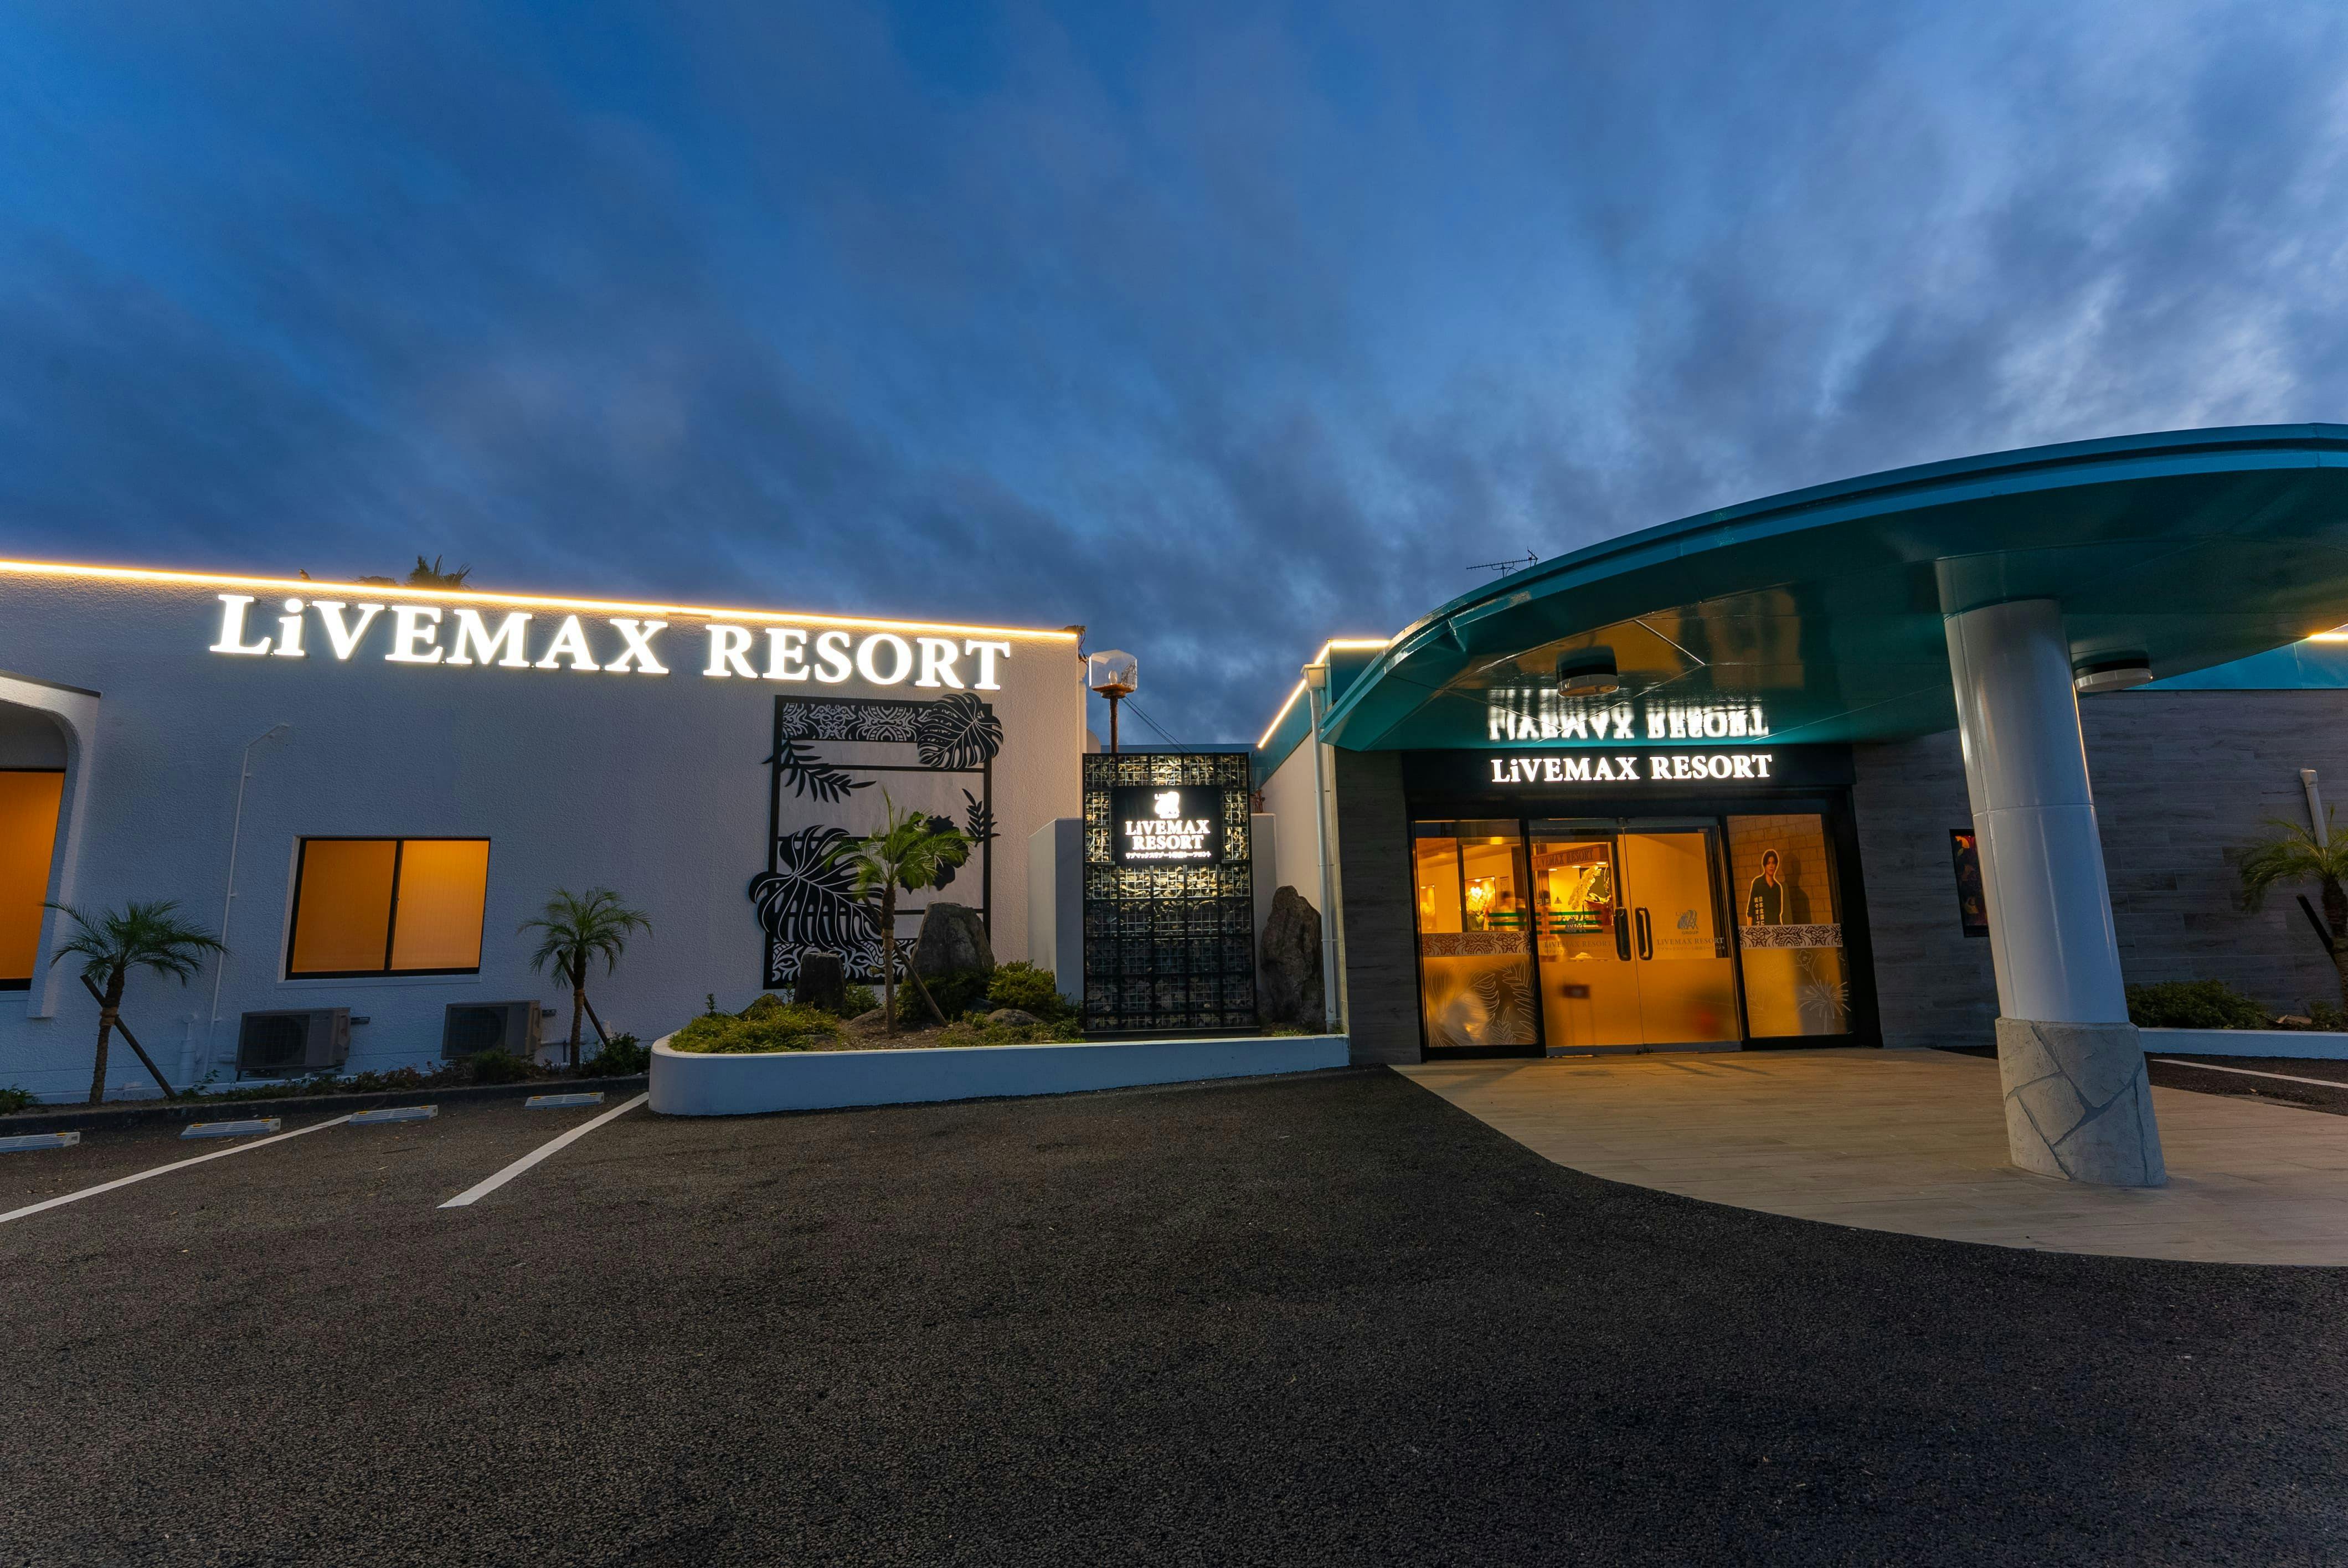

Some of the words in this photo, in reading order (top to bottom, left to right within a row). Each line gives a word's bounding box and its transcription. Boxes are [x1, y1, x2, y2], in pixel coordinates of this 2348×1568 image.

[209, 594, 670, 674] LiVEMAX
[702, 624, 1011, 690] RESORT
[1491, 757, 1640, 782] LiVEMAX
[1649, 755, 1773, 780] RESORT
[1125, 820, 1211, 835] LiVEMAX
[1132, 835, 1204, 850] RESORT
[1536, 854, 1564, 868] LVEMAX
[1566, 848, 1594, 863] RESORT
